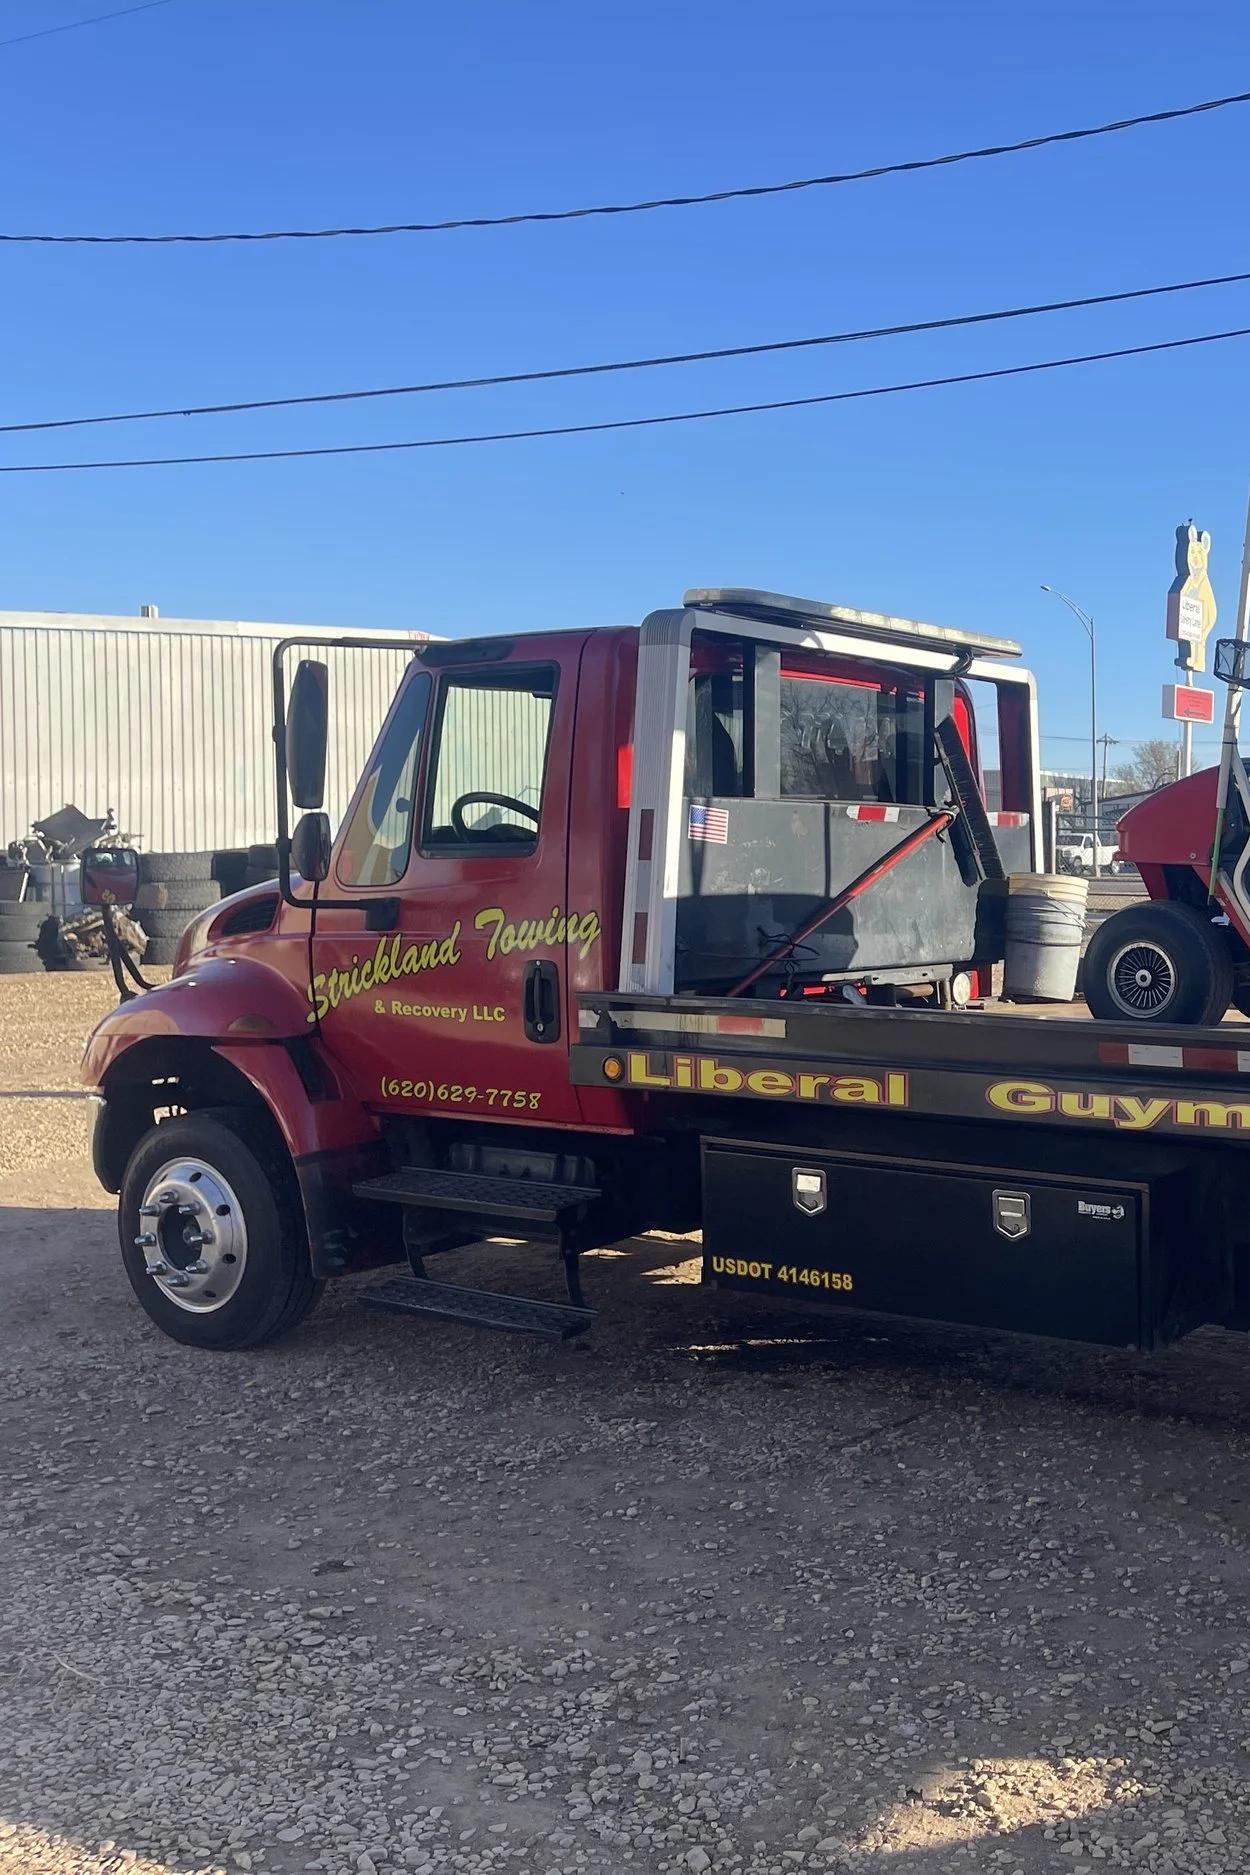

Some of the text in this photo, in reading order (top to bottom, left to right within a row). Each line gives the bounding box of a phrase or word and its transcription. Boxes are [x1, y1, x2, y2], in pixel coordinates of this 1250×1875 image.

[306, 905, 602, 1024] Strickland Towing
[374, 999, 506, 1023] & Recovery LLC
[381, 1076, 542, 1109] (620)629-7758
[627, 1051, 909, 1107] Liberal
[1077, 1200, 1111, 1215] Buyers
[712, 1255, 853, 1291] USDOT 4146158
